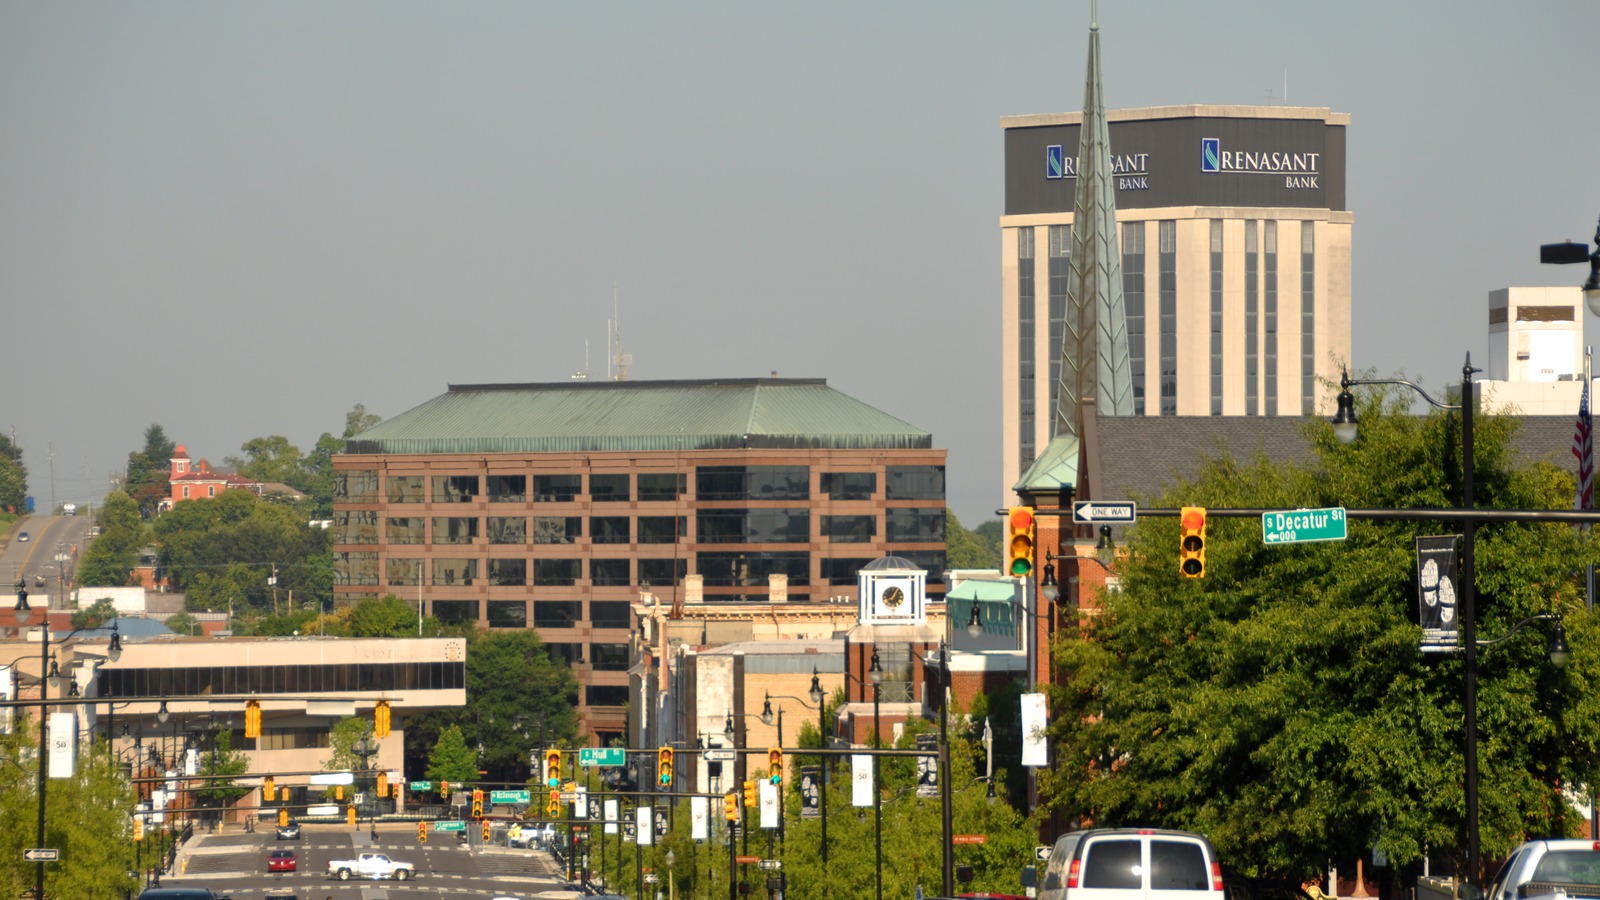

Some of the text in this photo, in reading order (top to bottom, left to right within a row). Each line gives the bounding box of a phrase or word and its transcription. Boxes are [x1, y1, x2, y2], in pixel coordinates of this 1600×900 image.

[1064, 153, 1149, 174] RSANT
[1220, 151, 1319, 171] RENASANT
[1119, 177, 1149, 190] BANK
[1285, 176, 1319, 189] BANK
[1091, 507, 1128, 516] ONE WAY
[1266, 509, 1343, 531] S Decatur St
[1279, 530, 1296, 541] 000
[592, 749, 607, 759] Hull
